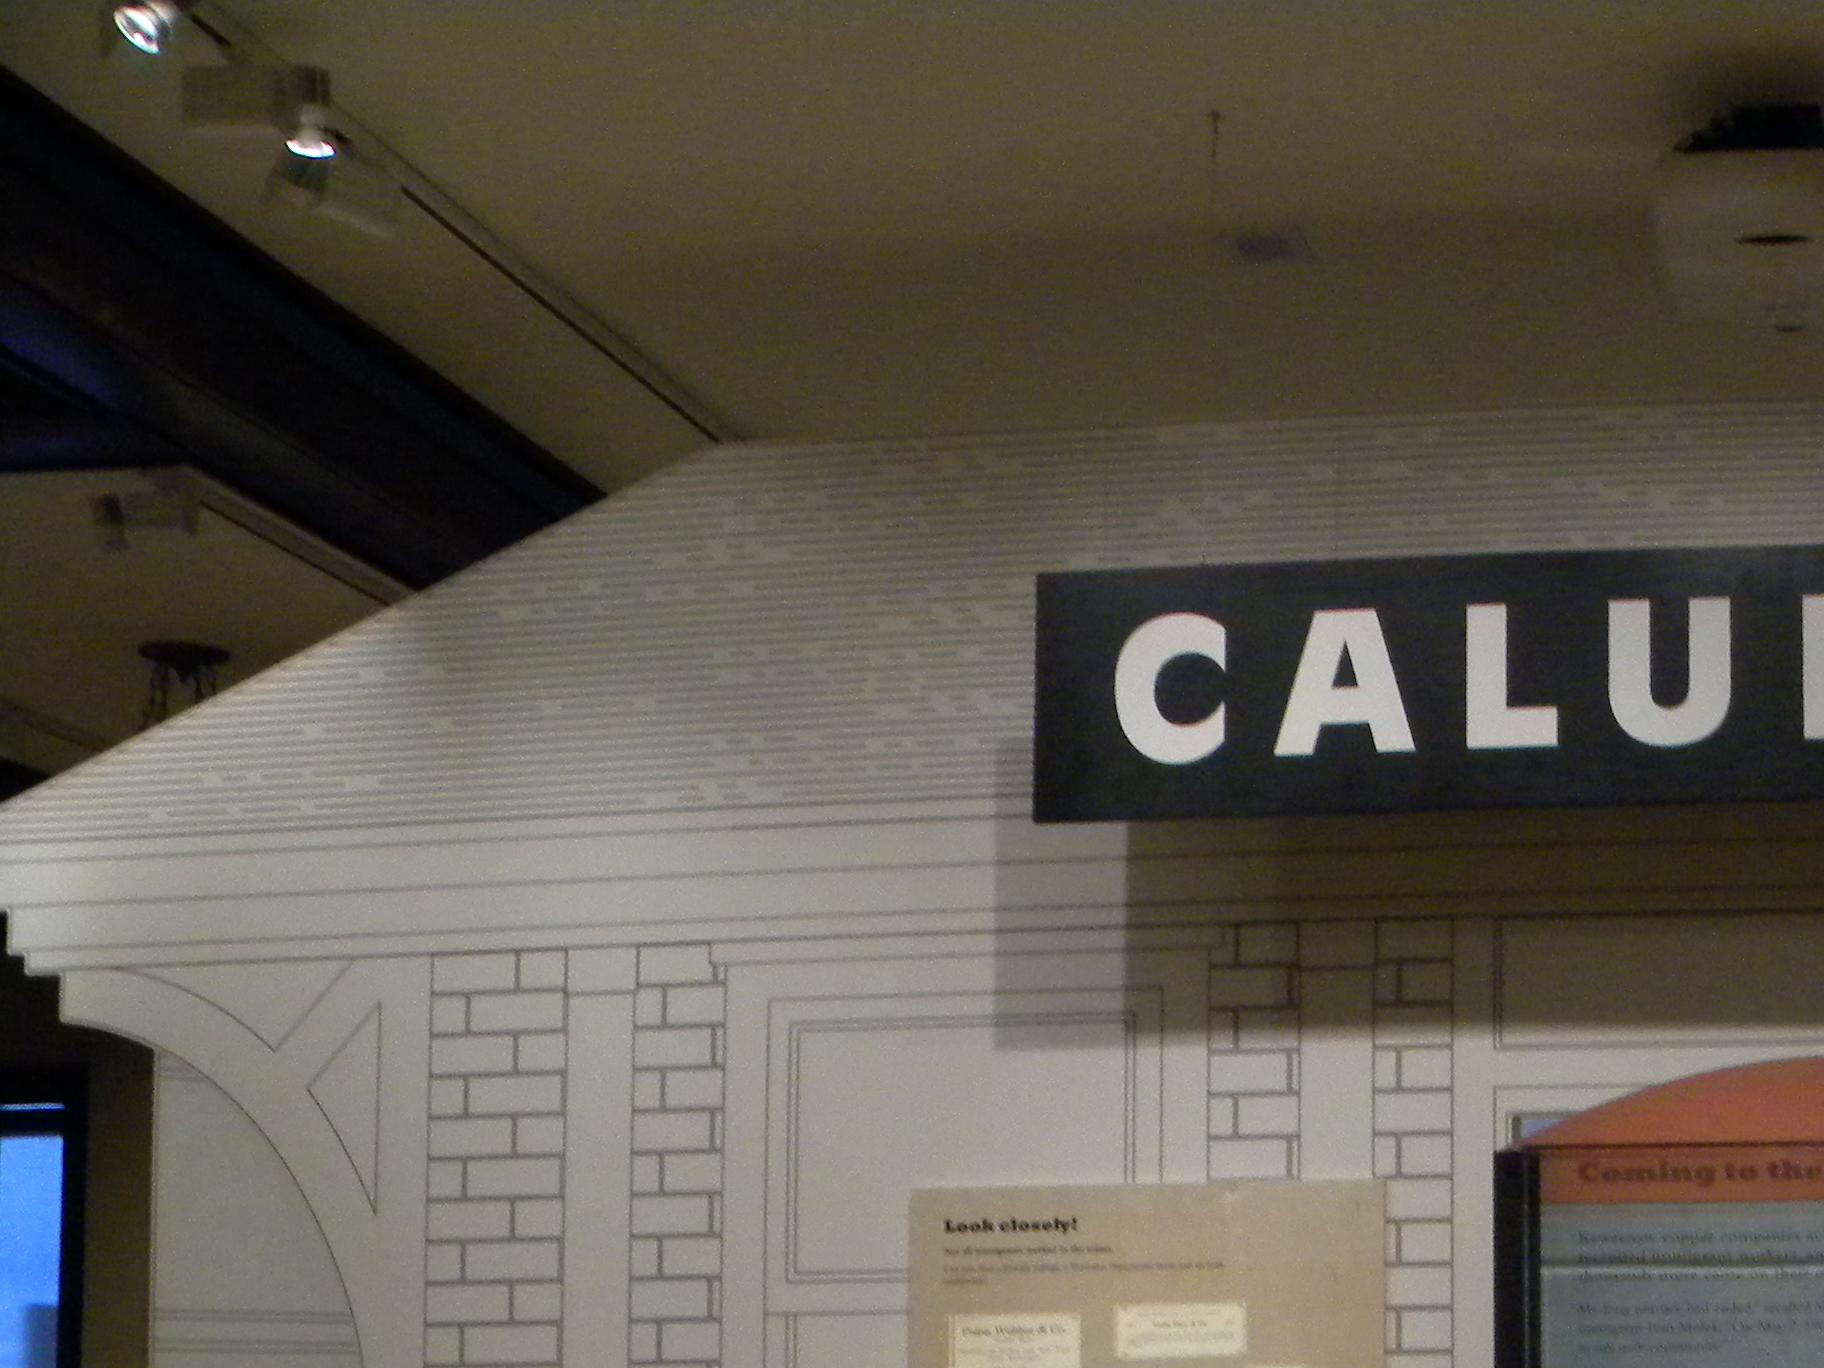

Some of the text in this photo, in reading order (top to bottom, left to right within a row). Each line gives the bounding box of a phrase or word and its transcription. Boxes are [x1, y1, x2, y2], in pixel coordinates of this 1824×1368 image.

[1578, 1160, 1716, 1187] Coming
[1724, 1162, 1758, 1181] to
[1767, 1159, 1822, 1180] the
[944, 1216, 1078, 1235] Look closely!
